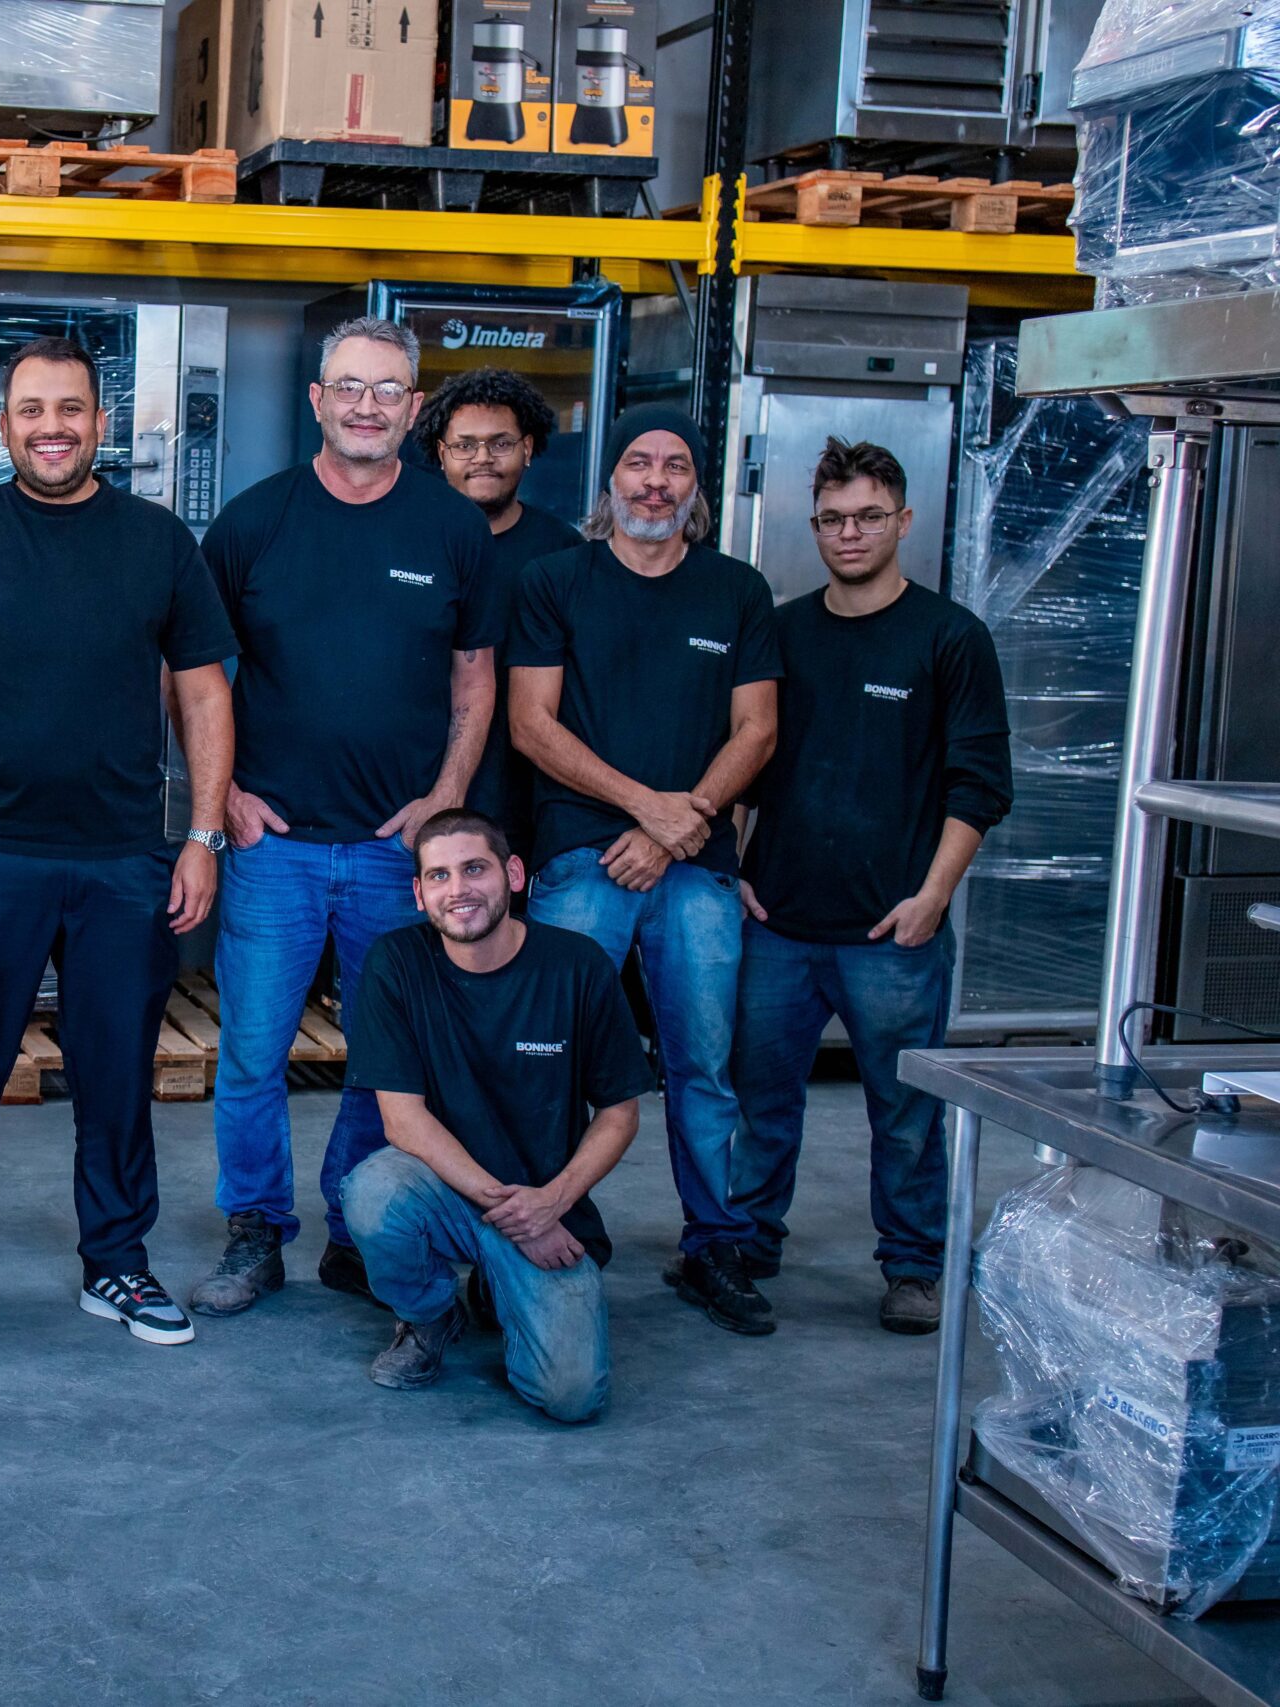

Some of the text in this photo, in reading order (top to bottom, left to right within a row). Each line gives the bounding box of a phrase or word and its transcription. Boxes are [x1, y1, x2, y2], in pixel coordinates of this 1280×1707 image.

[470, 326, 546, 348] Imbera
[390, 569, 432, 584] BONNKE
[689, 638, 728, 654] BONNKE
[864, 683, 908, 700] BONNKE
[516, 1042, 562, 1052] BONNKE
[1120, 1401, 1168, 1436] BECCARO
[1246, 1432, 1280, 1440] BECCARO
